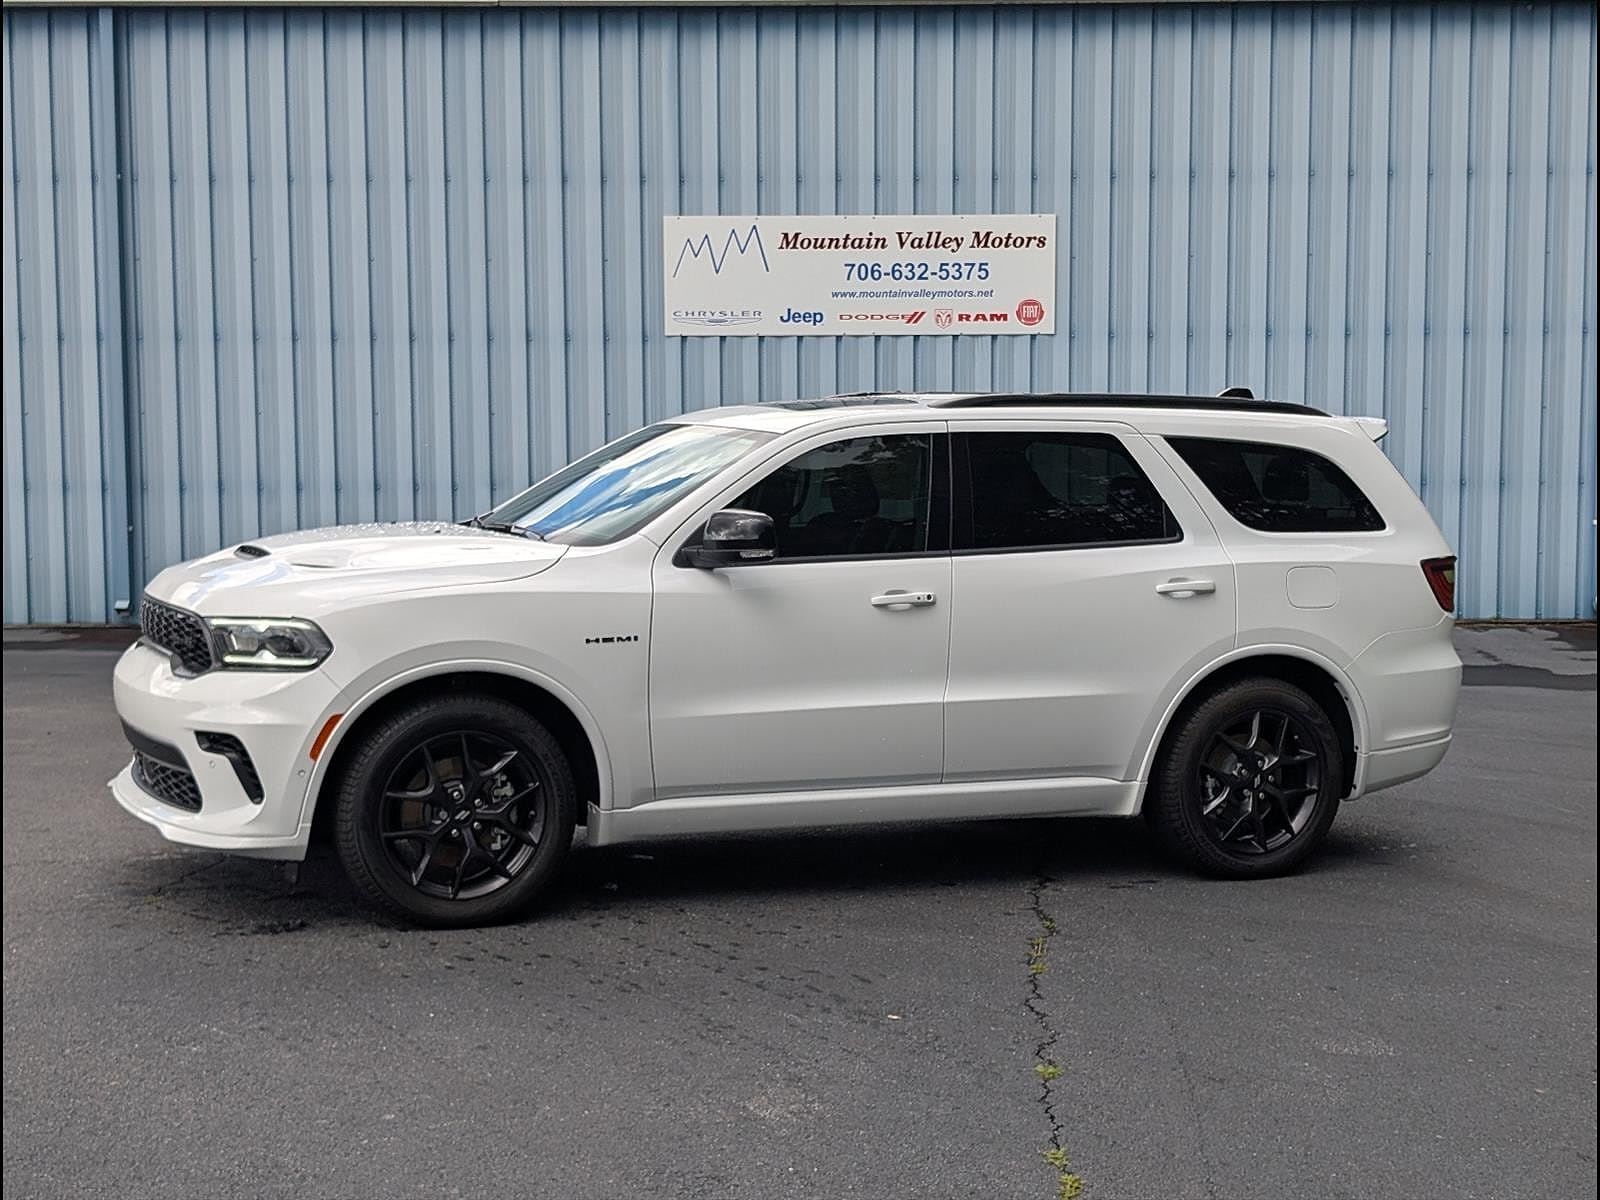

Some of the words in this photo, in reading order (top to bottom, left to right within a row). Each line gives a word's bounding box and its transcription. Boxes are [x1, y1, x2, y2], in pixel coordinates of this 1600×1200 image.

[778, 231, 888, 250] Mountain
[896, 231, 964, 253] Valley
[969, 231, 1047, 249] Motors
[844, 262, 990, 281] 706-632-5375
[831, 289, 994, 300] www.mountainvalleymotors.net
[672, 310, 763, 318] CHRYSLER
[779, 308, 824, 326] Jeep
[839, 313, 912, 322] DODGE
[957, 313, 1009, 322] RAM
